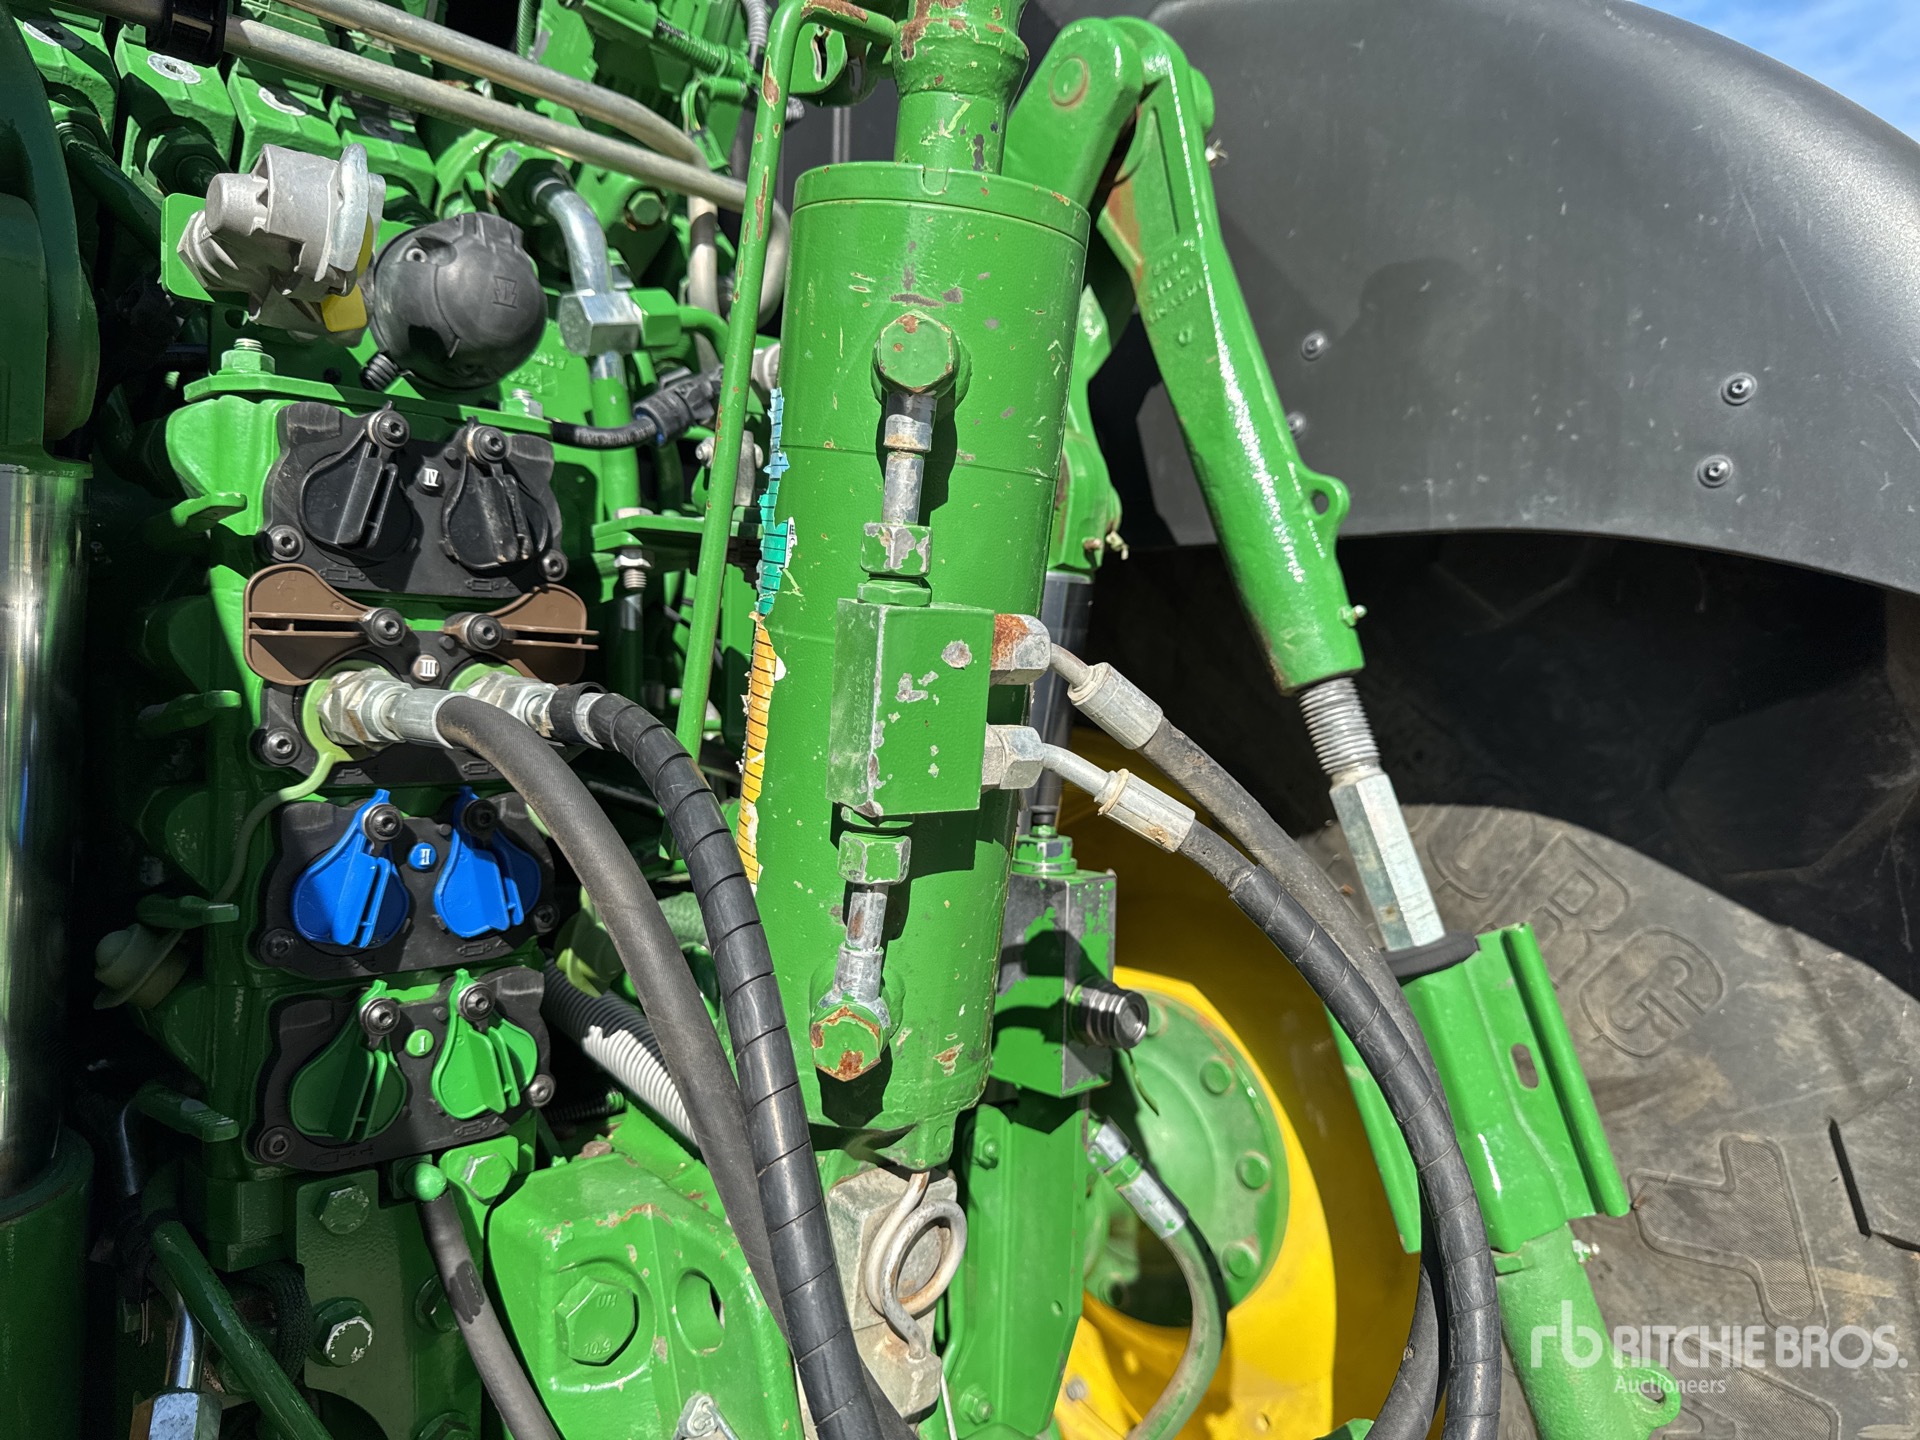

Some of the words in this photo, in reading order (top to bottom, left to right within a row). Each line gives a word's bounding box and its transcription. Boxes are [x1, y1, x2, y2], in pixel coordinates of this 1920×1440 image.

[423, 467, 439, 487] IV
[419, 659, 437, 677] III
[584, 1338, 612, 1357] 10.9
